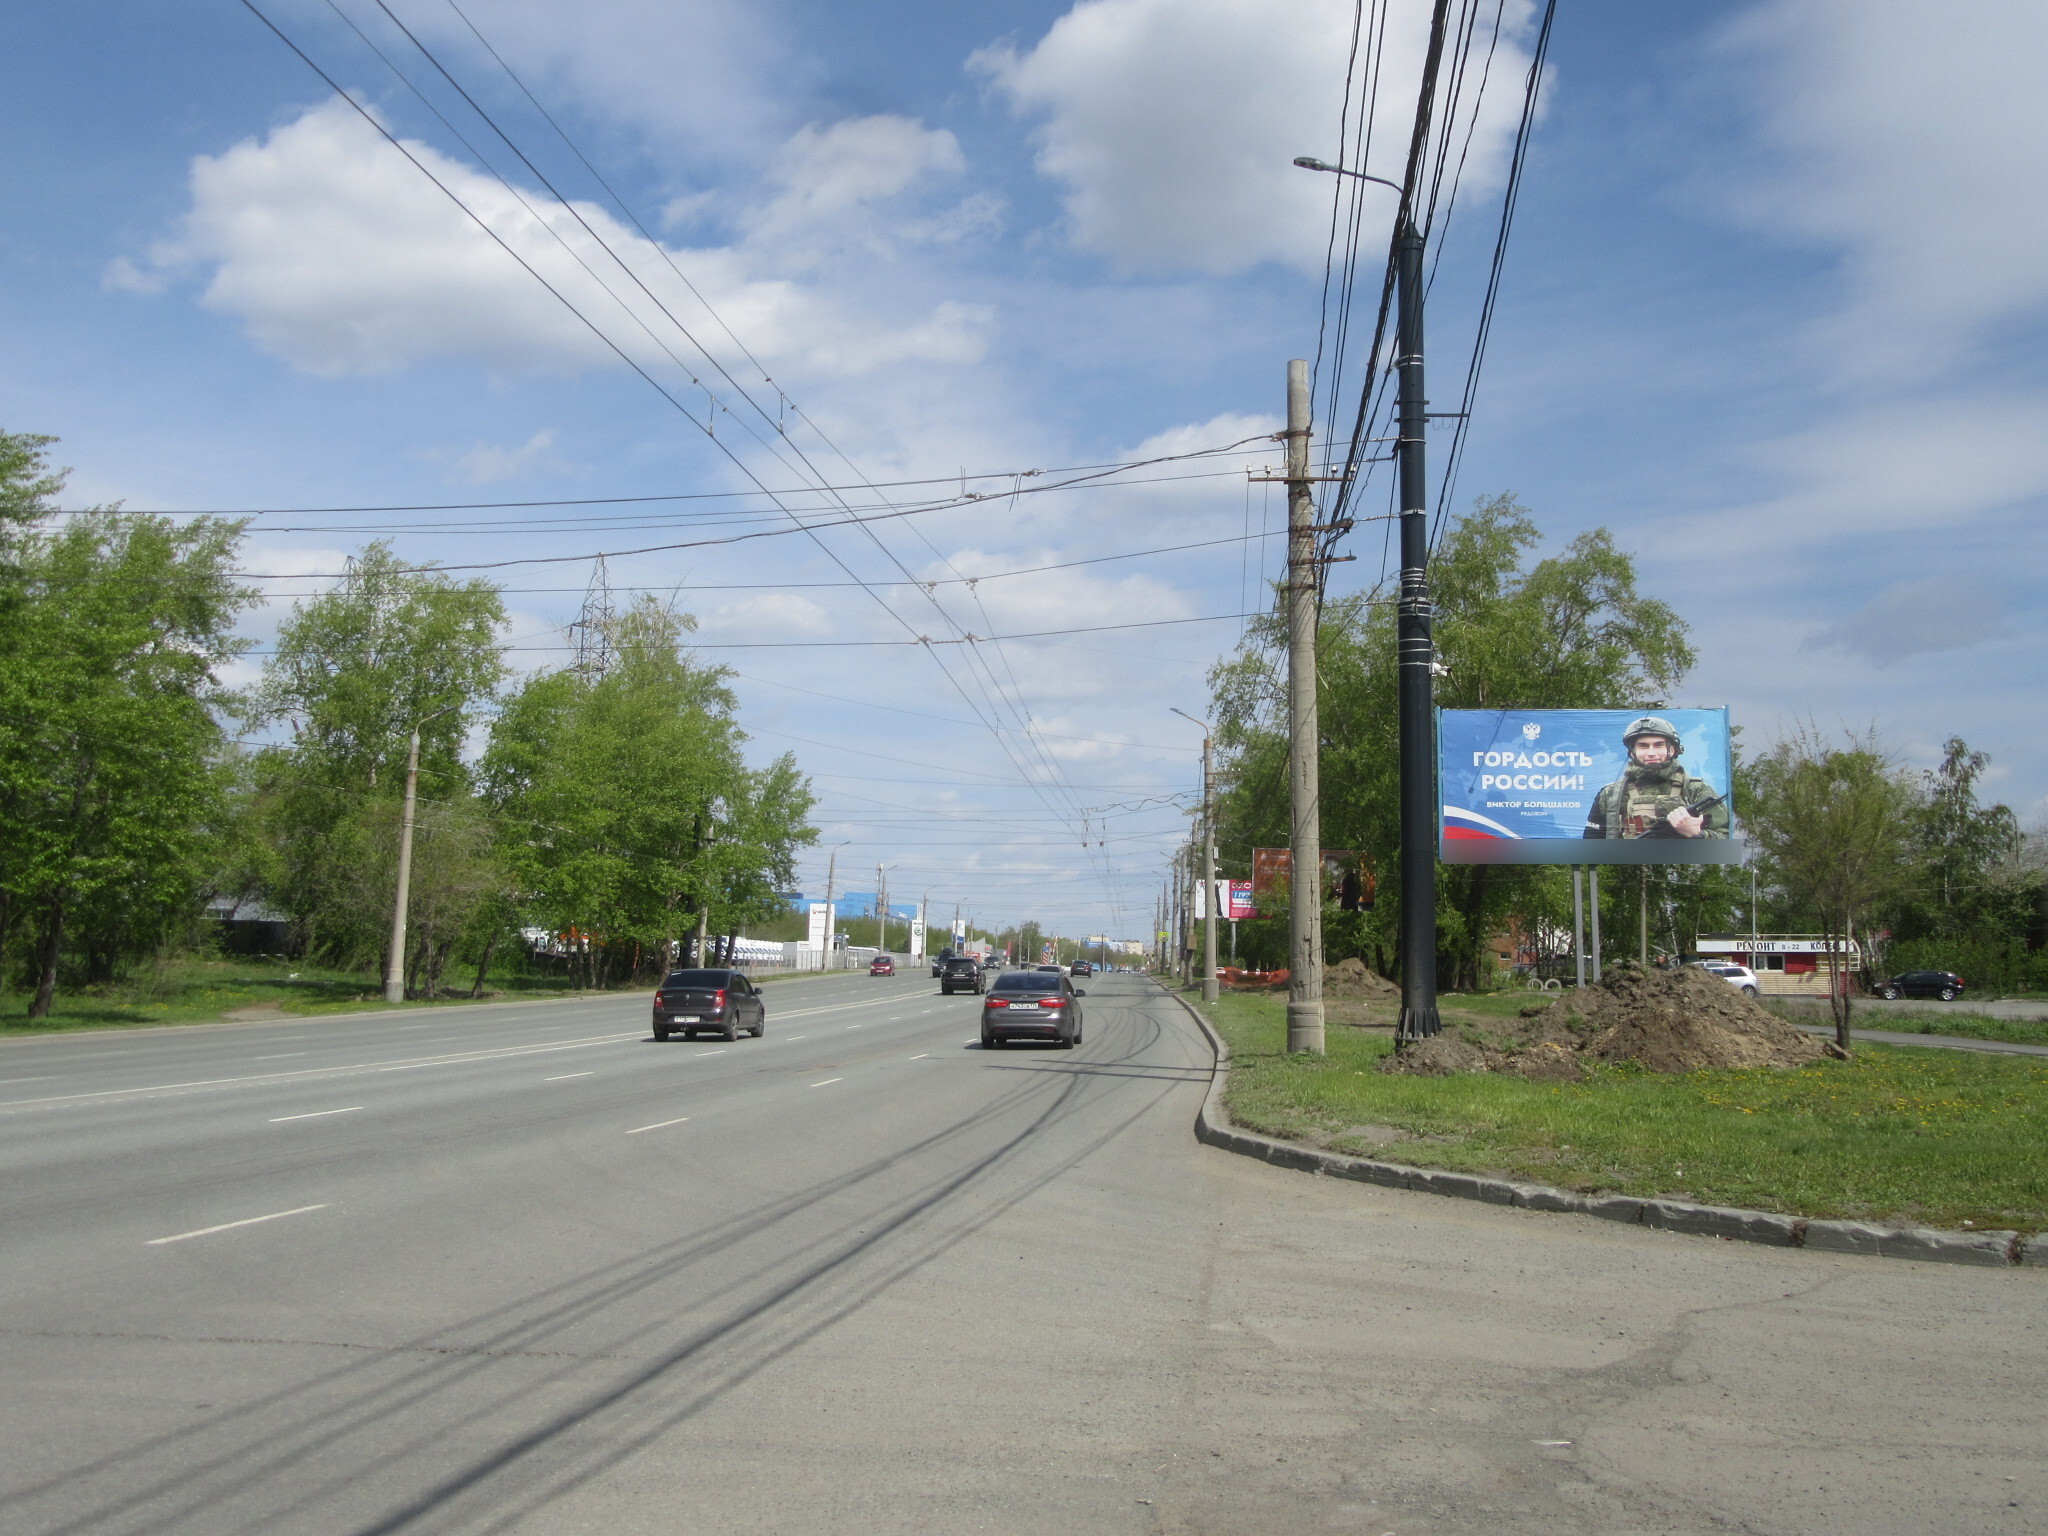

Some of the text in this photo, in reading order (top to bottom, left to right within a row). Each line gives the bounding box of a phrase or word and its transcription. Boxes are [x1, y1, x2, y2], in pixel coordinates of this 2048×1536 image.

[1473, 751, 1593, 769] ГОРДОСТЬ
[1481, 774, 1584, 790] РОССИИ!
[1736, 941, 1776, 951] РЕМОНТ
